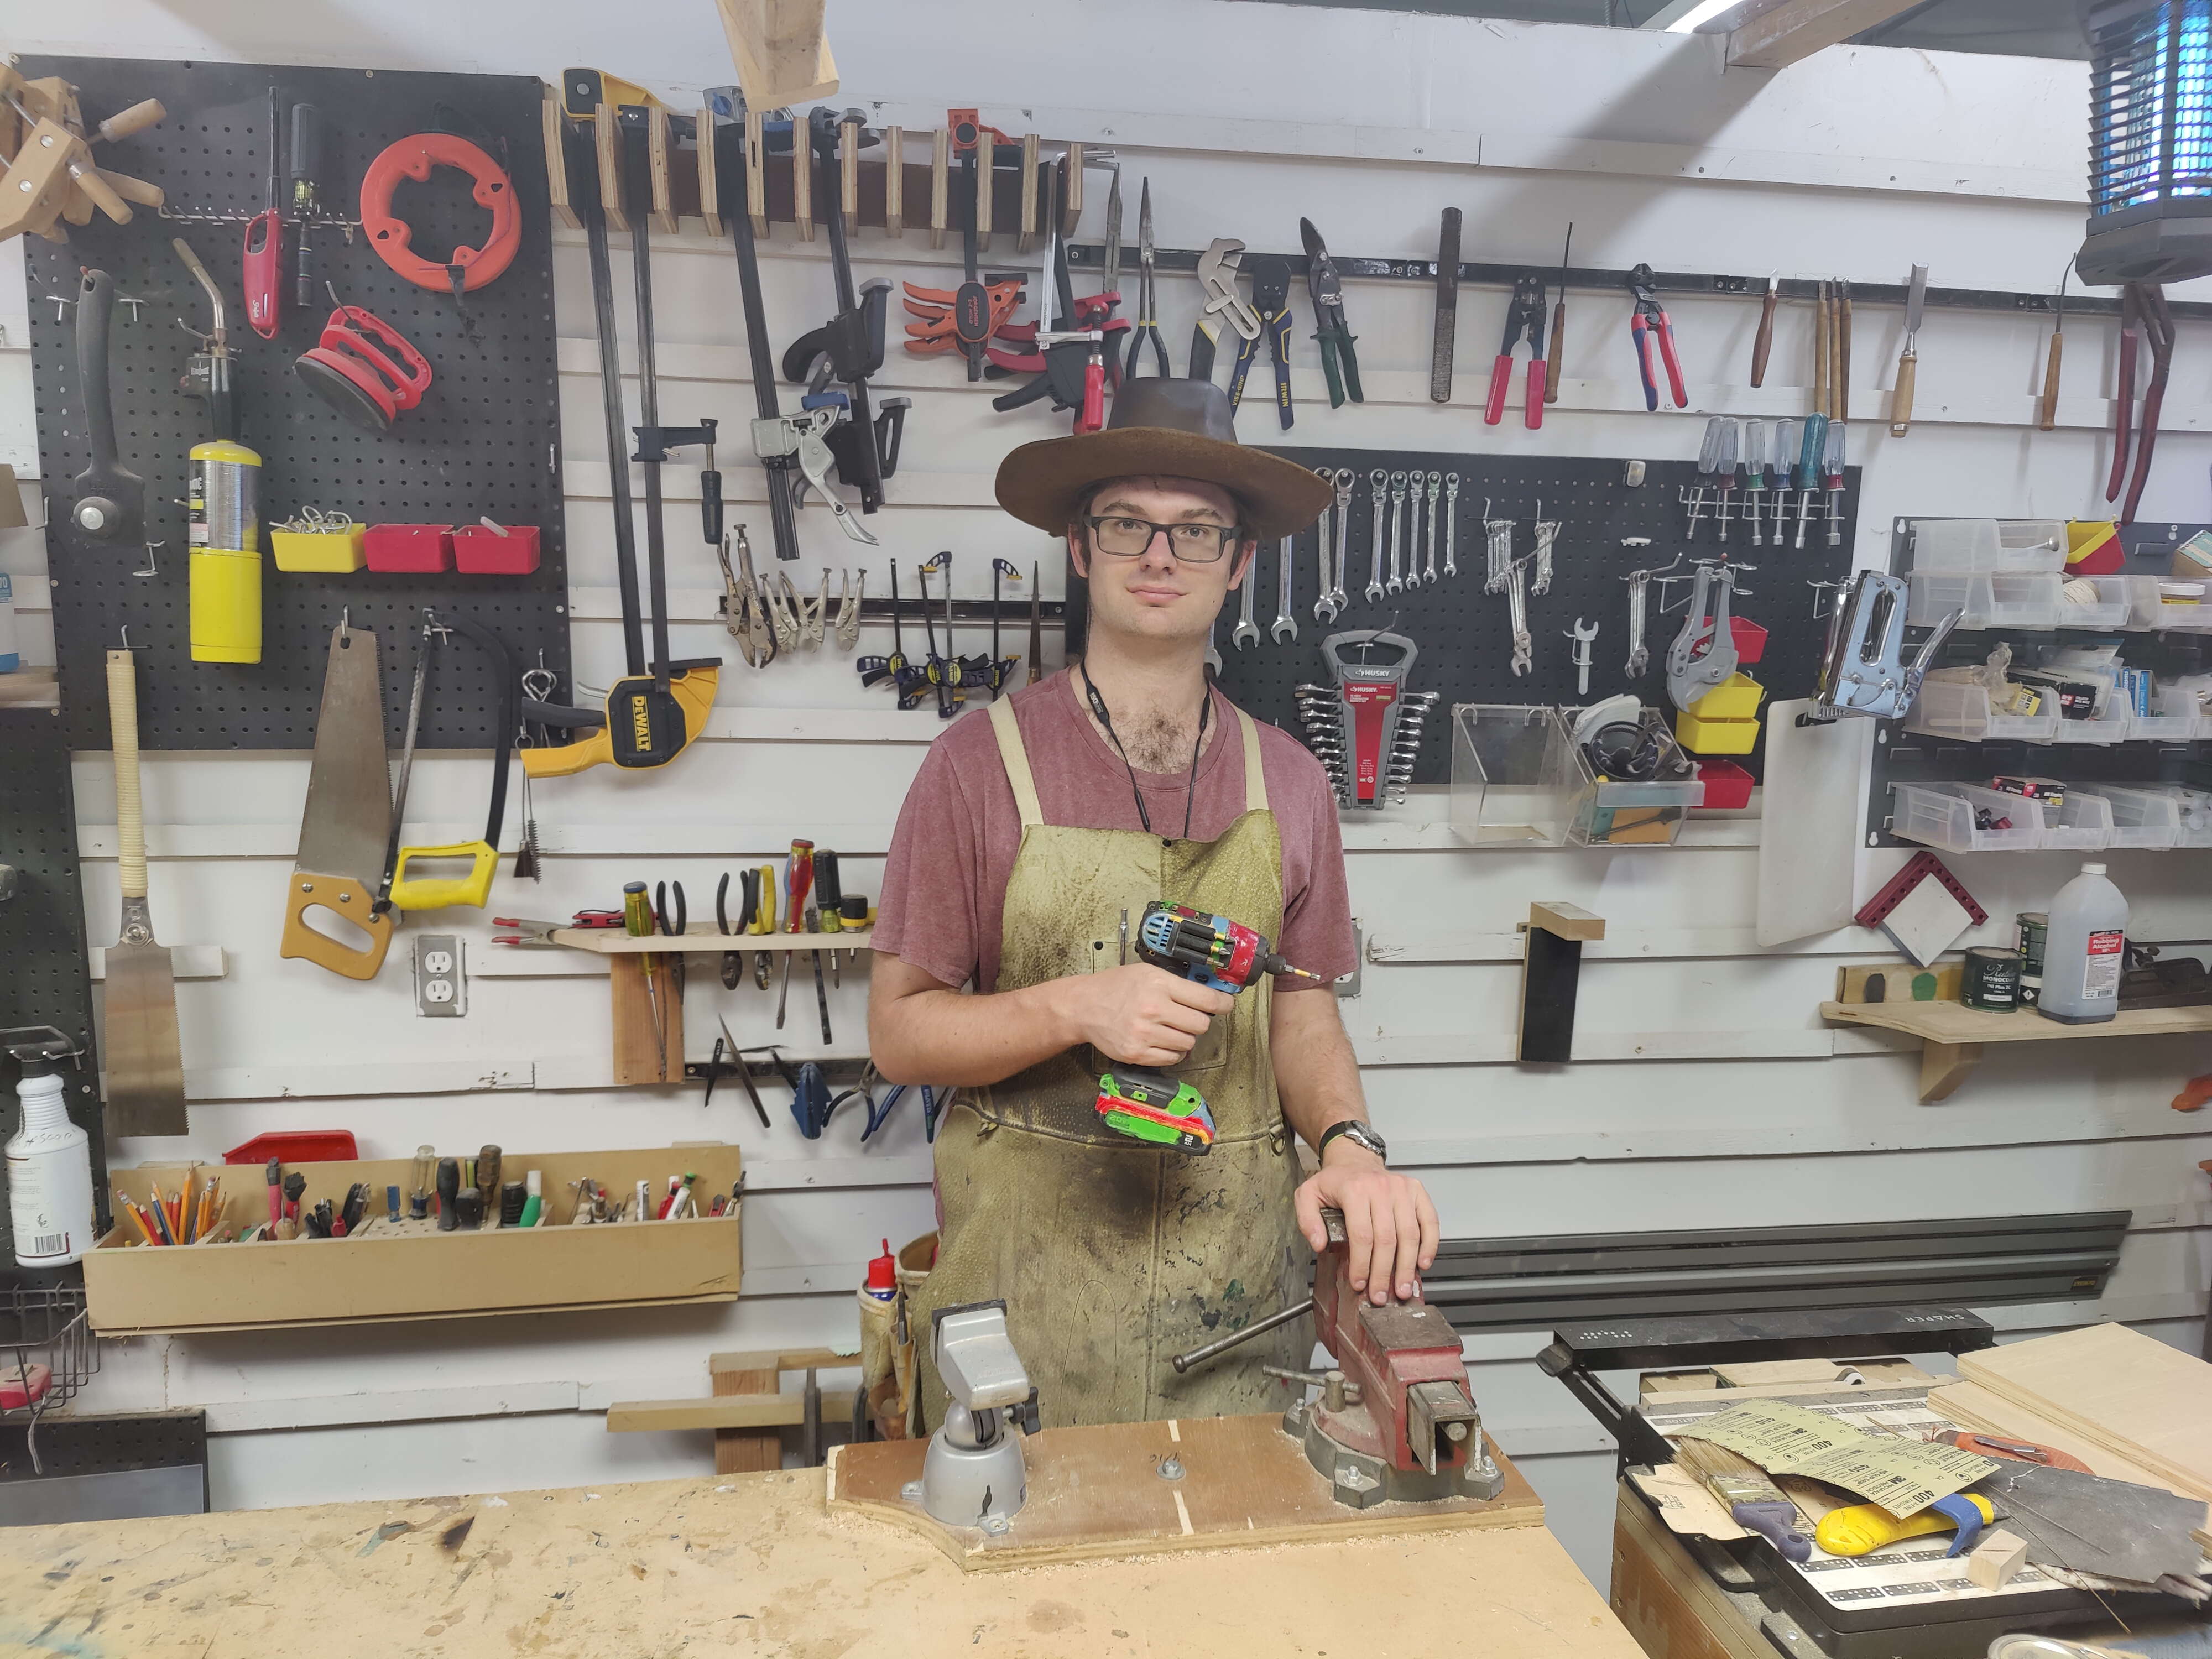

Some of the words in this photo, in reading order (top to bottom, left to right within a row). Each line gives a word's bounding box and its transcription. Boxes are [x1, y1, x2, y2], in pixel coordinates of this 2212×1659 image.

[1232, 375, 1245, 406] VISE-GRIP
[1280, 382, 1288, 407] IRWIN
[633, 696, 650, 752] DEWALT
[1811, 1438, 1832, 1451] 400
[1963, 1463, 1983, 1473] FINISHES
[1887, 1476, 1906, 1484] 3M
[1865, 1481, 1888, 1492] PRECISION
[1912, 1490, 1934, 1503] 400
[1892, 1498, 1912, 1509] FINISHES
[1903, 1501, 1918, 1510] X-FINE
